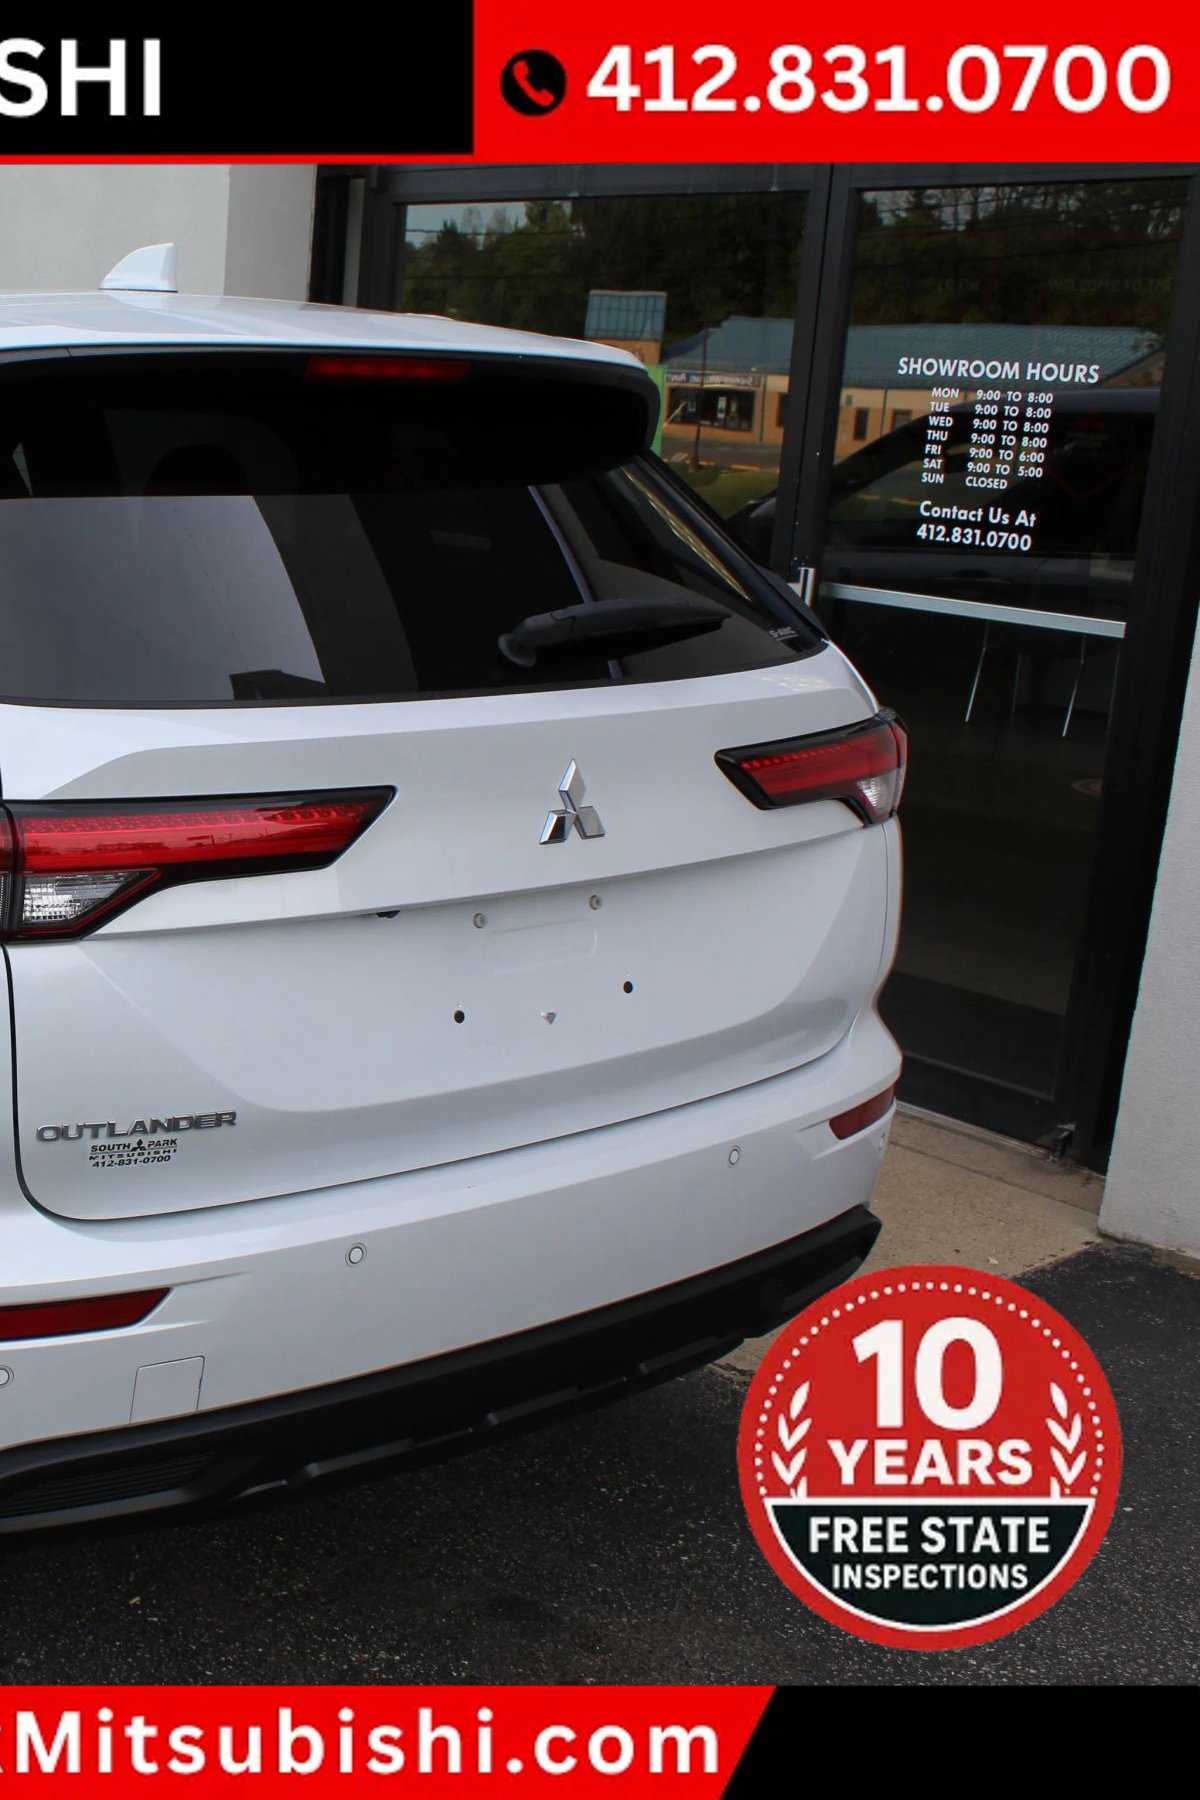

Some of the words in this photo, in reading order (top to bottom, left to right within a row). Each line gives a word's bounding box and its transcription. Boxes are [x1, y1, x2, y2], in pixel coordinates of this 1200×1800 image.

[897, 356, 1020, 380] SHOWROOM
[1026, 362, 1100, 384] HOURS
[931, 387, 960, 399] MON
[976, 389, 1000, 400] 9:00
[1007, 391, 1021, 402] TO
[1027, 392, 1053, 404] 8:00
[930, 402, 950, 413] TUE
[974, 404, 998, 416] 9:00
[1004, 406, 1019, 417] TO
[1025, 407, 1051, 419] 8:00
[928, 416, 953, 427] WED
[973, 418, 997, 430] 9:00
[1003, 420, 1018, 432] TO
[1023, 422, 1049, 434] 8:00
[927, 430, 948, 441] THU
[971, 433, 995, 445] 9:00
[1001, 435, 1016, 446] TO
[1021, 436, 1047, 448] 8:00
[925, 444, 942, 455] FRI
[969, 447, 993, 459] 9:00
[999, 449, 1014, 461] TO
[1019, 451, 1045, 463] 6:00
[923, 458, 942, 469] SAT
[967, 461, 990, 473] 9:00
[995, 464, 1010, 475] TO
[1017, 466, 1043, 478] 5:00
[921, 472, 944, 484] SUN
[965, 476, 1008, 490] CLOSED
[919, 500, 984, 522] Contact
[988, 507, 1010, 525] Us
[1015, 510, 1036, 528] At
[916, 524, 1032, 551] 412.831.0700
[36, 1109, 237, 1141] OUTLANDER
[90, 1142, 131, 1152] SOUTH
[147, 1138, 178, 1148] PARK
[88, 1148, 177, 1161] MITSUBISHI
[92, 1154, 171, 1167] 412-831-0700
